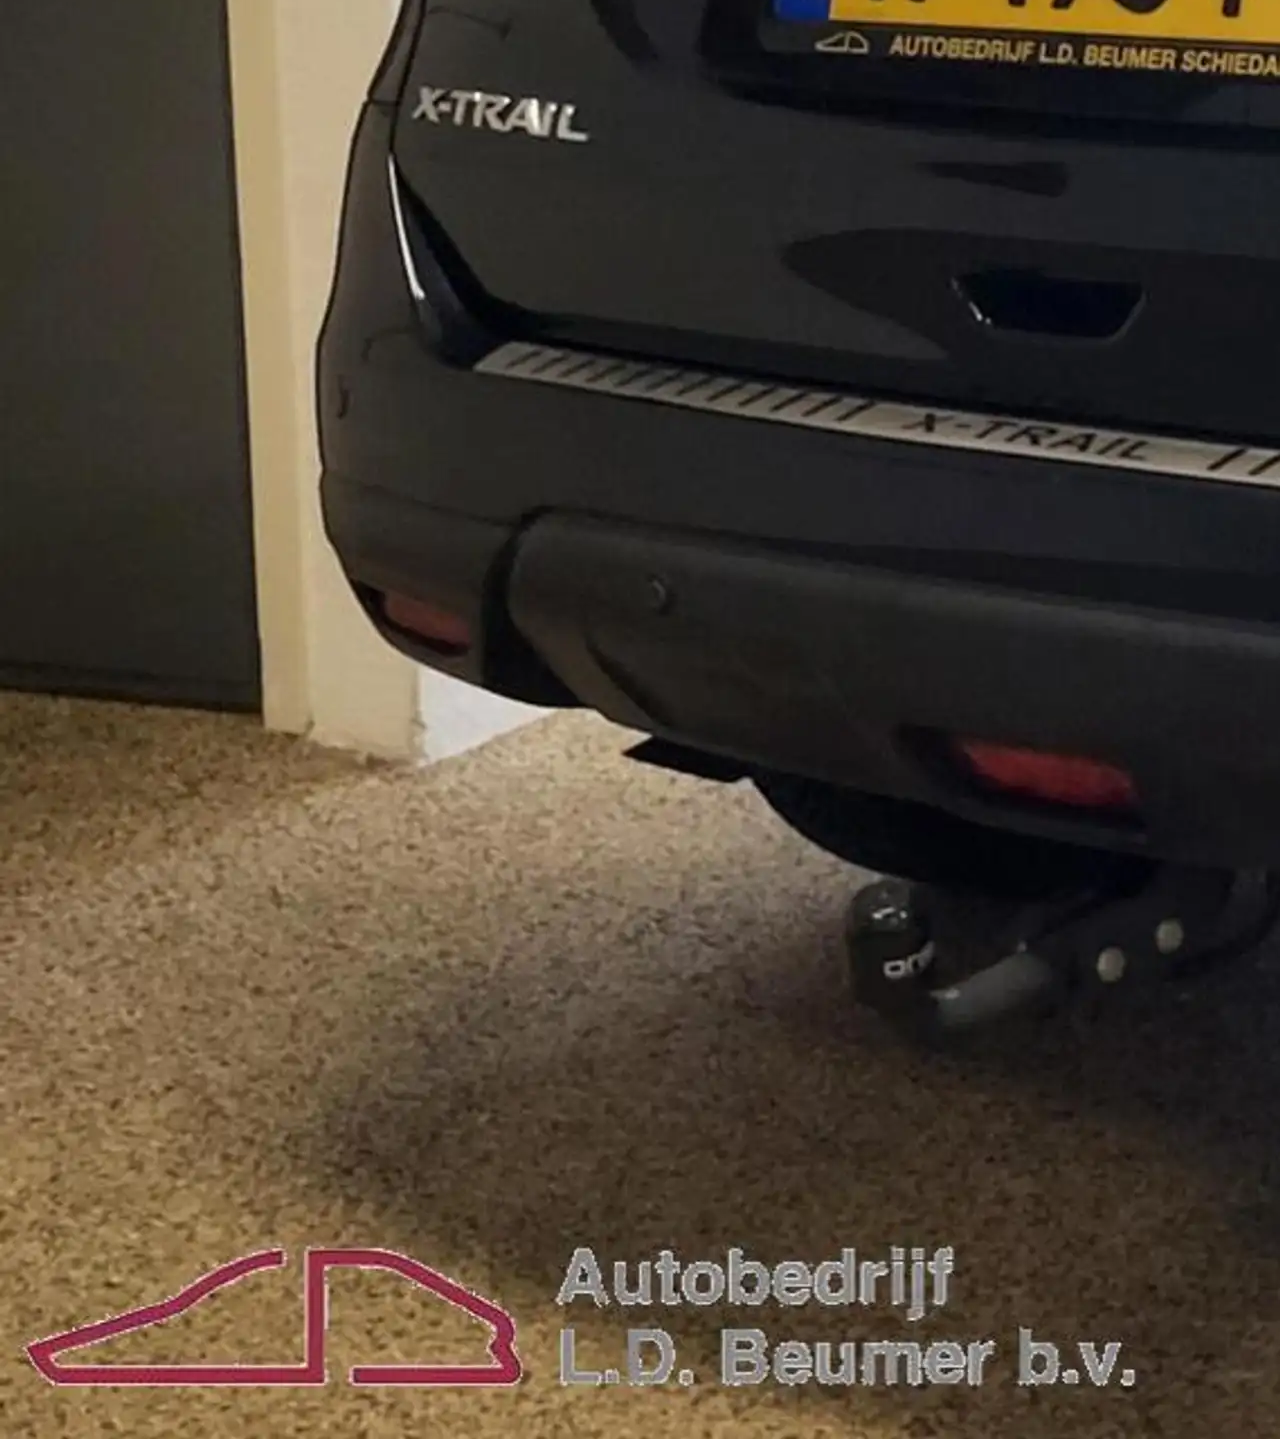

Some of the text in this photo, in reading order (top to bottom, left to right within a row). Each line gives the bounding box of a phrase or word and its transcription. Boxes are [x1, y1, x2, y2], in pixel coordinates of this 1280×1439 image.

[889, 34, 1036, 63] AUTOBEDRIJF
[1039, 41, 1078, 64] L.D.
[1083, 43, 1177, 72] BEUMER
[412, 85, 590, 142] X-TRAIL
[902, 412, 1149, 461] X-TRAIL
